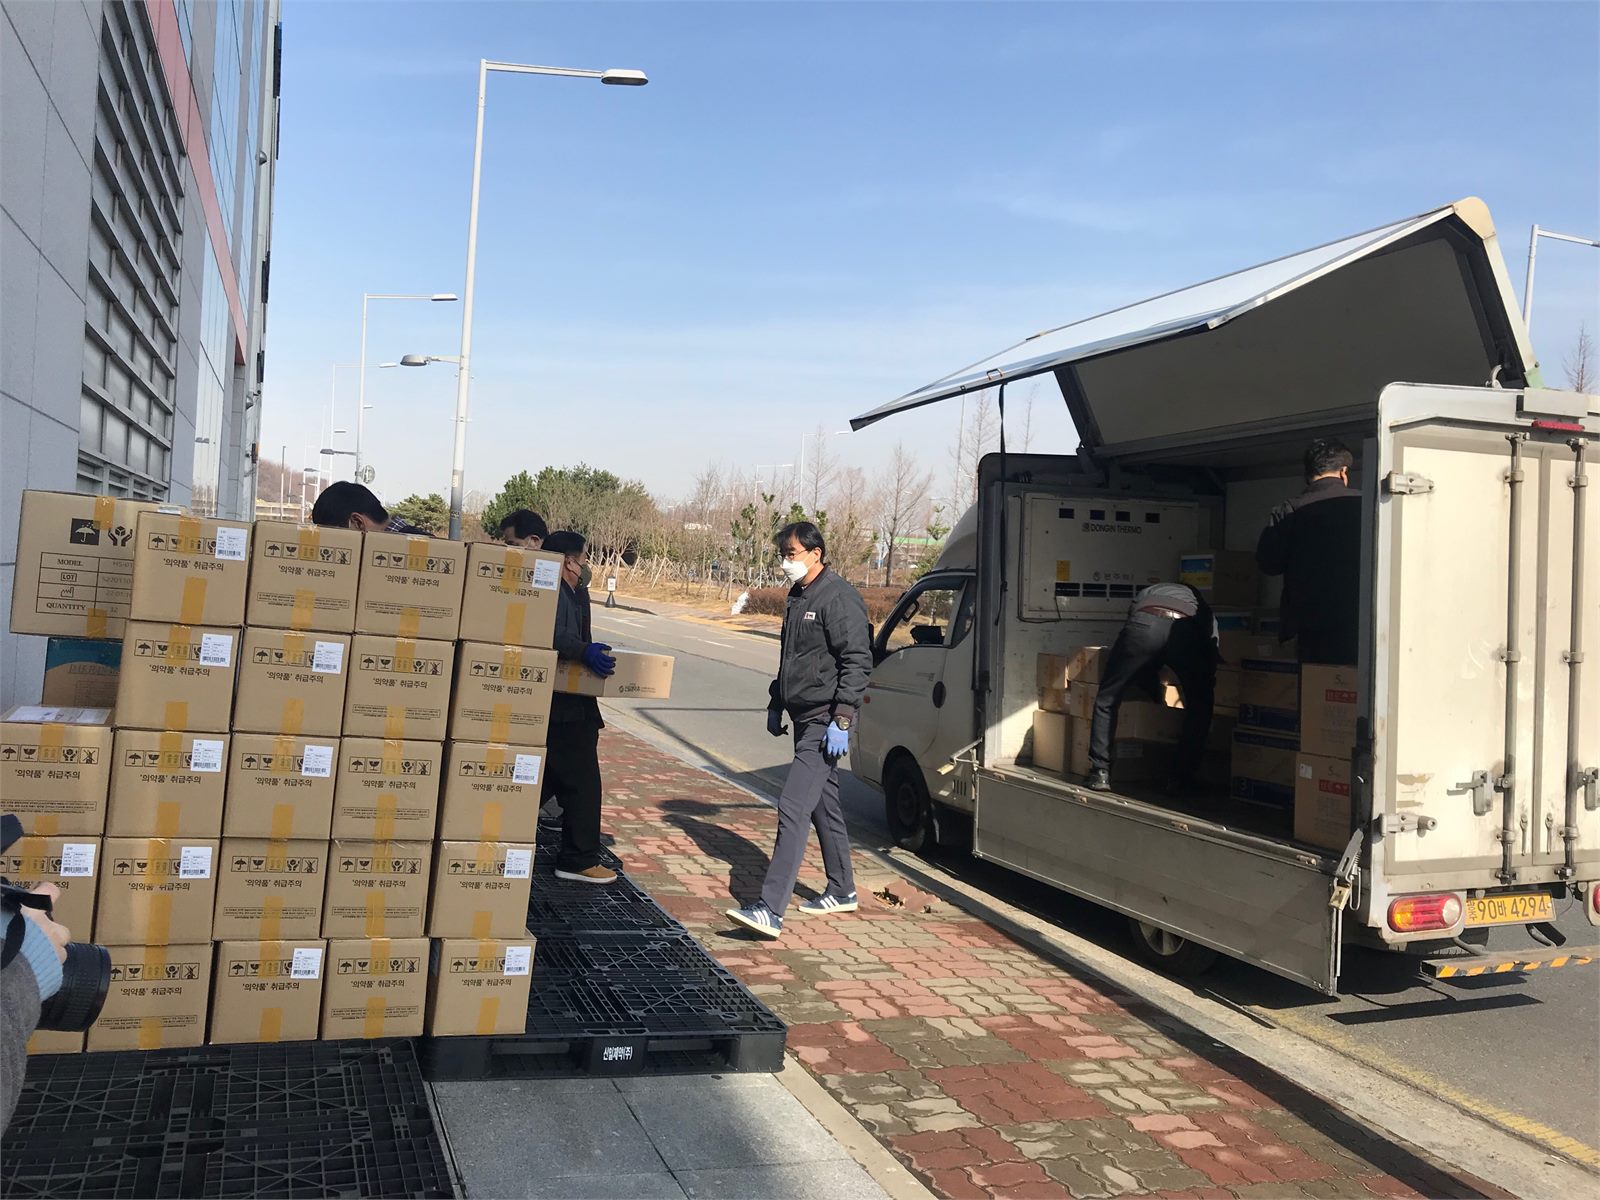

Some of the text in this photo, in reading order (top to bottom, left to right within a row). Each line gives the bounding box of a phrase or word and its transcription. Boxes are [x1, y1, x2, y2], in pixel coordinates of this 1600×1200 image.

[1117, 525, 1142, 534] THERMO
[57, 558, 84, 567] MODEL
[194, 560, 224, 571] 취급주의
[307, 567, 335, 579] 취급주의
[412, 577, 440, 588] 취급주의
[46, 602, 86, 611] QUANTITY
[179, 666, 210, 677] 취급주의
[295, 672, 324, 684] 취급주의
[400, 678, 427, 689] 취급주의
[507, 684, 532, 696] 취급주의
[47, 770, 80, 780] 취급주의
[170, 774, 202, 785] 취급주의
[283, 777, 312, 787] 취급주의
[389, 780, 416, 790] 취급주의
[496, 784, 522, 794] 취급주의
[273, 879, 302, 889] 취급주의
[379, 879, 406, 889] 취급주의
[484, 881, 510, 891] 취급주의
[1477, 900, 1508, 920] 90바
[1511, 896, 1548, 918] 4294
[270, 982, 300, 992] 취급주의
[378, 978, 405, 988] 취급주의
[486, 978, 512, 988] 취급주의
[151, 986, 182, 996] 취급주의
